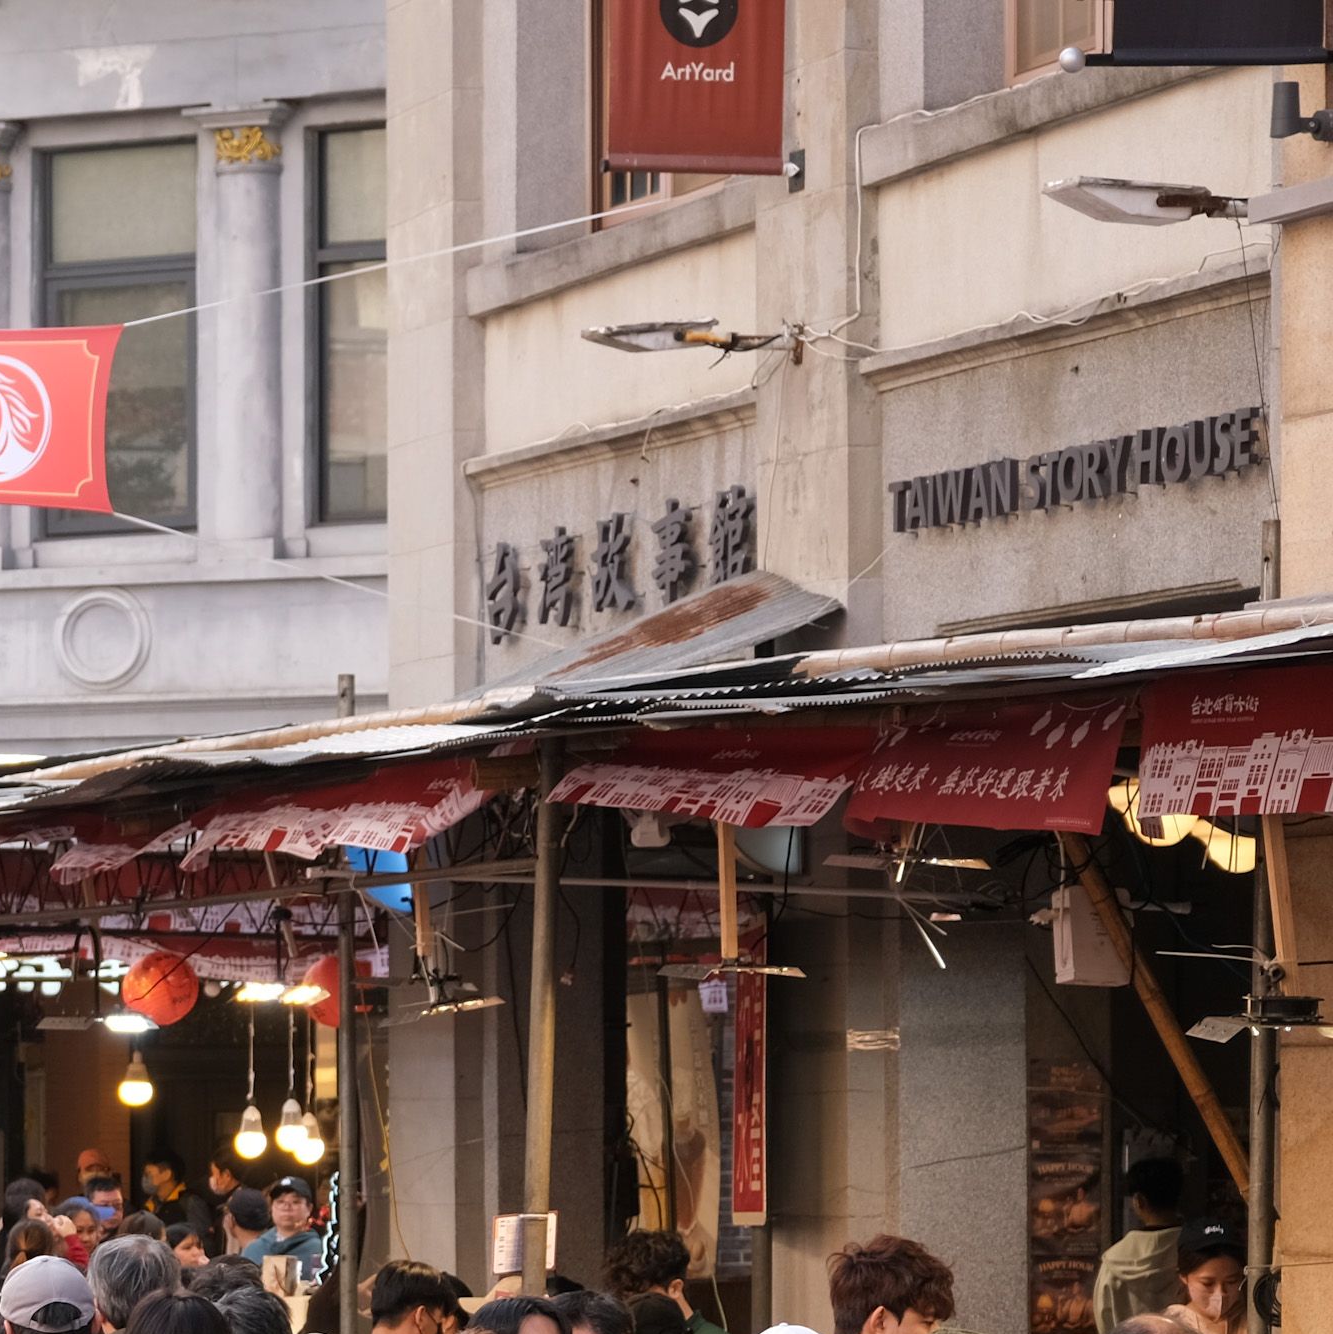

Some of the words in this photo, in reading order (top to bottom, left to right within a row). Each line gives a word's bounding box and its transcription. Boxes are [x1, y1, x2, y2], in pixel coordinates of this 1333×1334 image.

[660, 61, 735, 82] ArtYard
[888, 457, 1020, 534] TAIWAN
[1023, 434, 1135, 511] STORY
[1132, 406, 1261, 486] HOUSE
